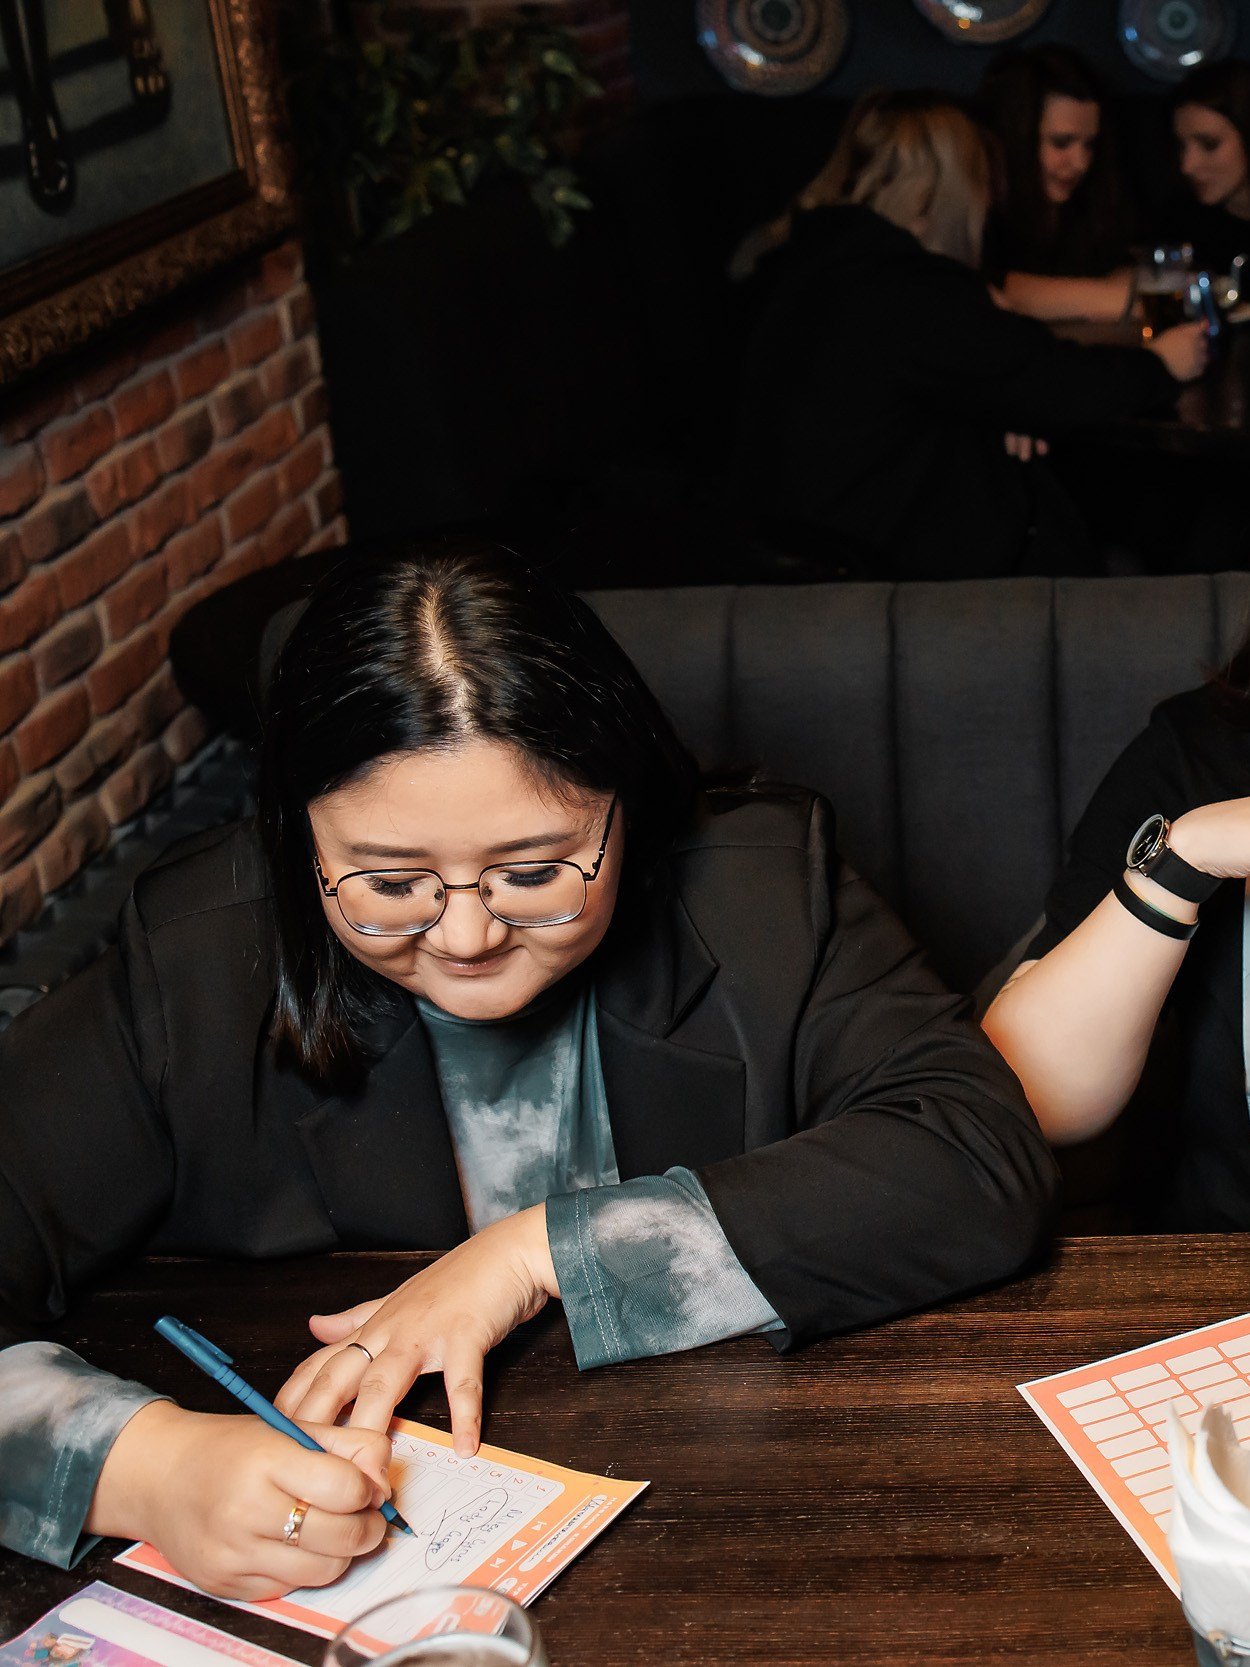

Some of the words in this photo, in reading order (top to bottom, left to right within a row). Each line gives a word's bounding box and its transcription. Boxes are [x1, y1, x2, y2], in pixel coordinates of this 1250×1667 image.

[408, 1444, 418, 1453] 7
[446, 1457, 458, 1465] 5
[488, 1470, 502, 1478] 3
[512, 1476, 523, 1484] 2
[535, 1484, 546, 1492] 1
[458, 1495, 497, 1523] Lady
[479, 1504, 522, 1532] Miley
[445, 1538, 486, 1562] Cyrus
